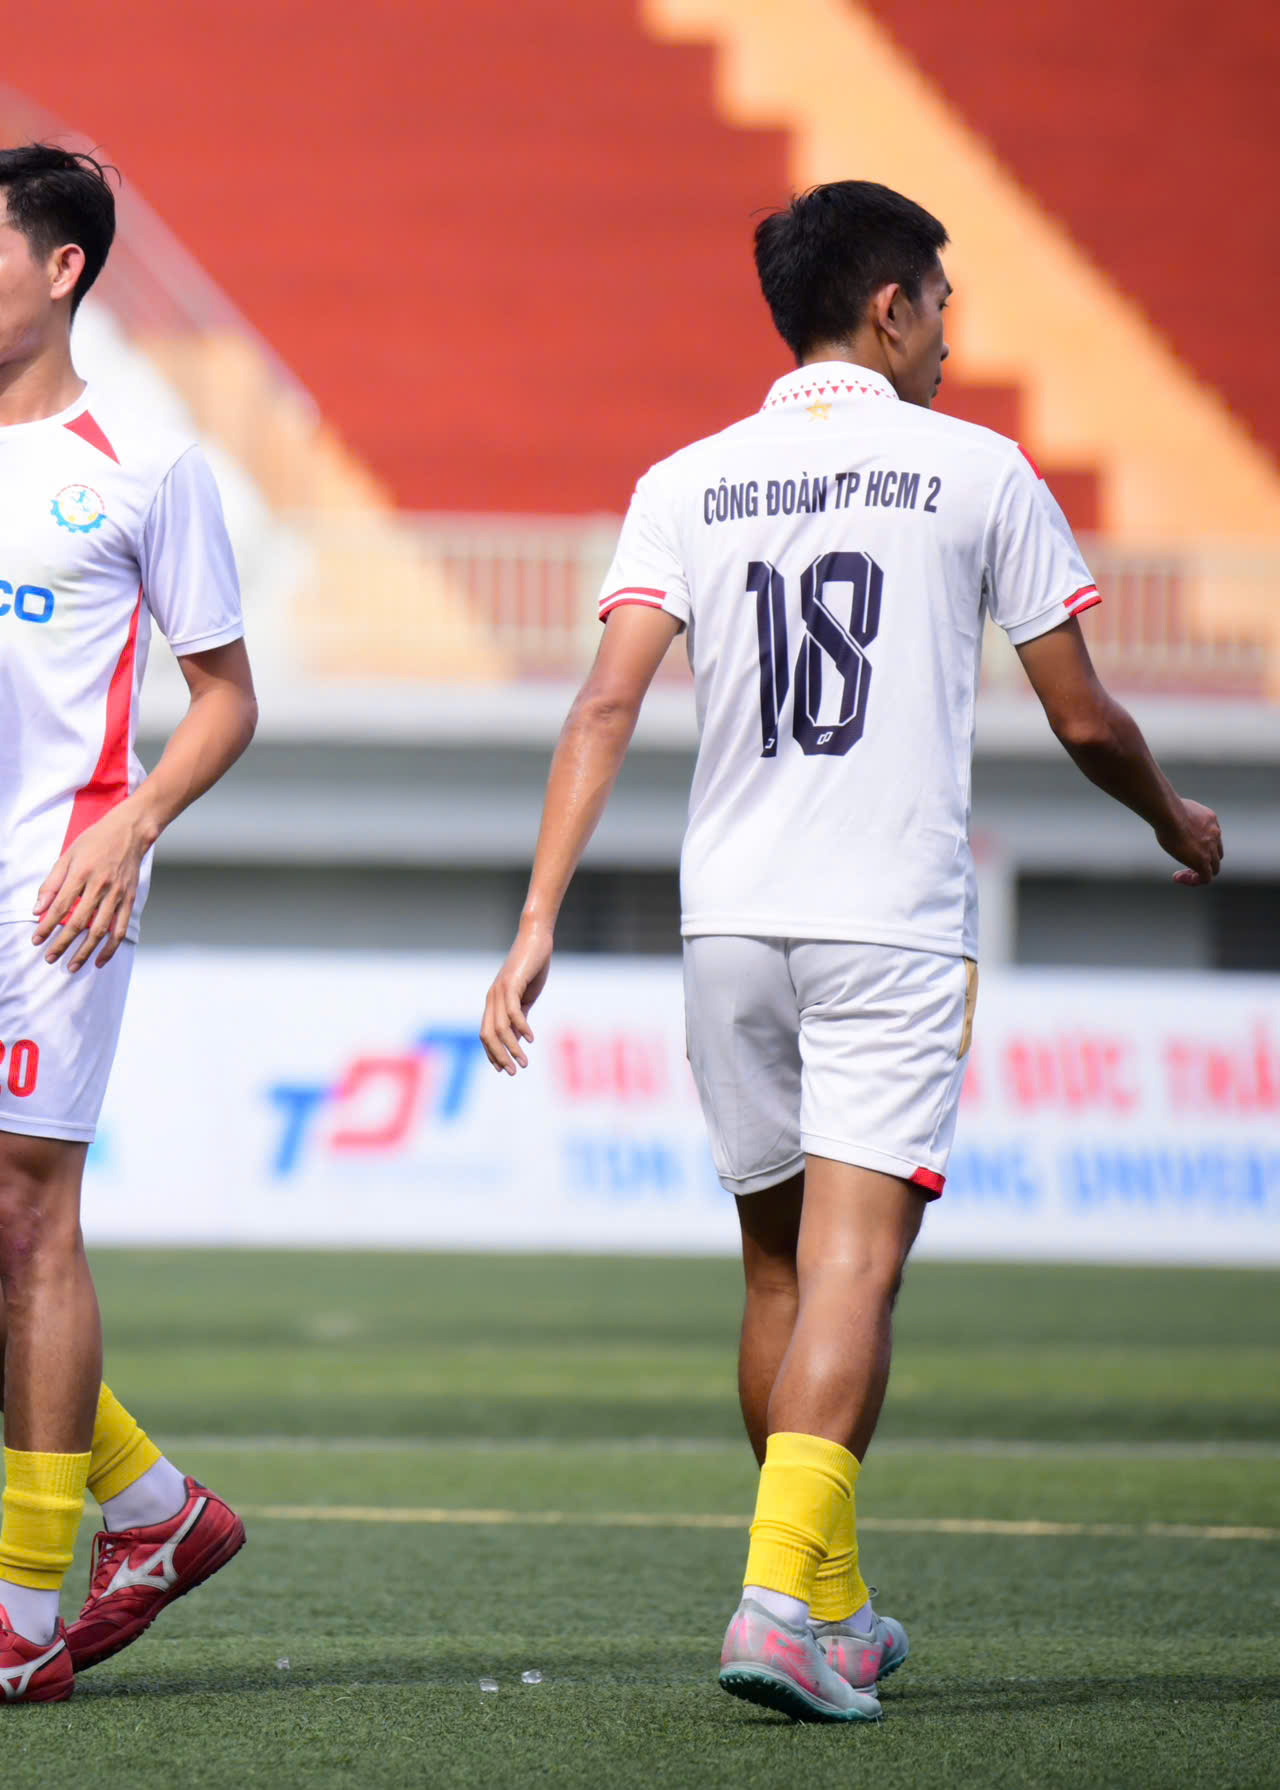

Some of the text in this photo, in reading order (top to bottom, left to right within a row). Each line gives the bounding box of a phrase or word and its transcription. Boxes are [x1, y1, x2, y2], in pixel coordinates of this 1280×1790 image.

[704, 471, 941, 525] CÔNG ĐOÀN TP HCM 2
[746, 552, 884, 758] 18
